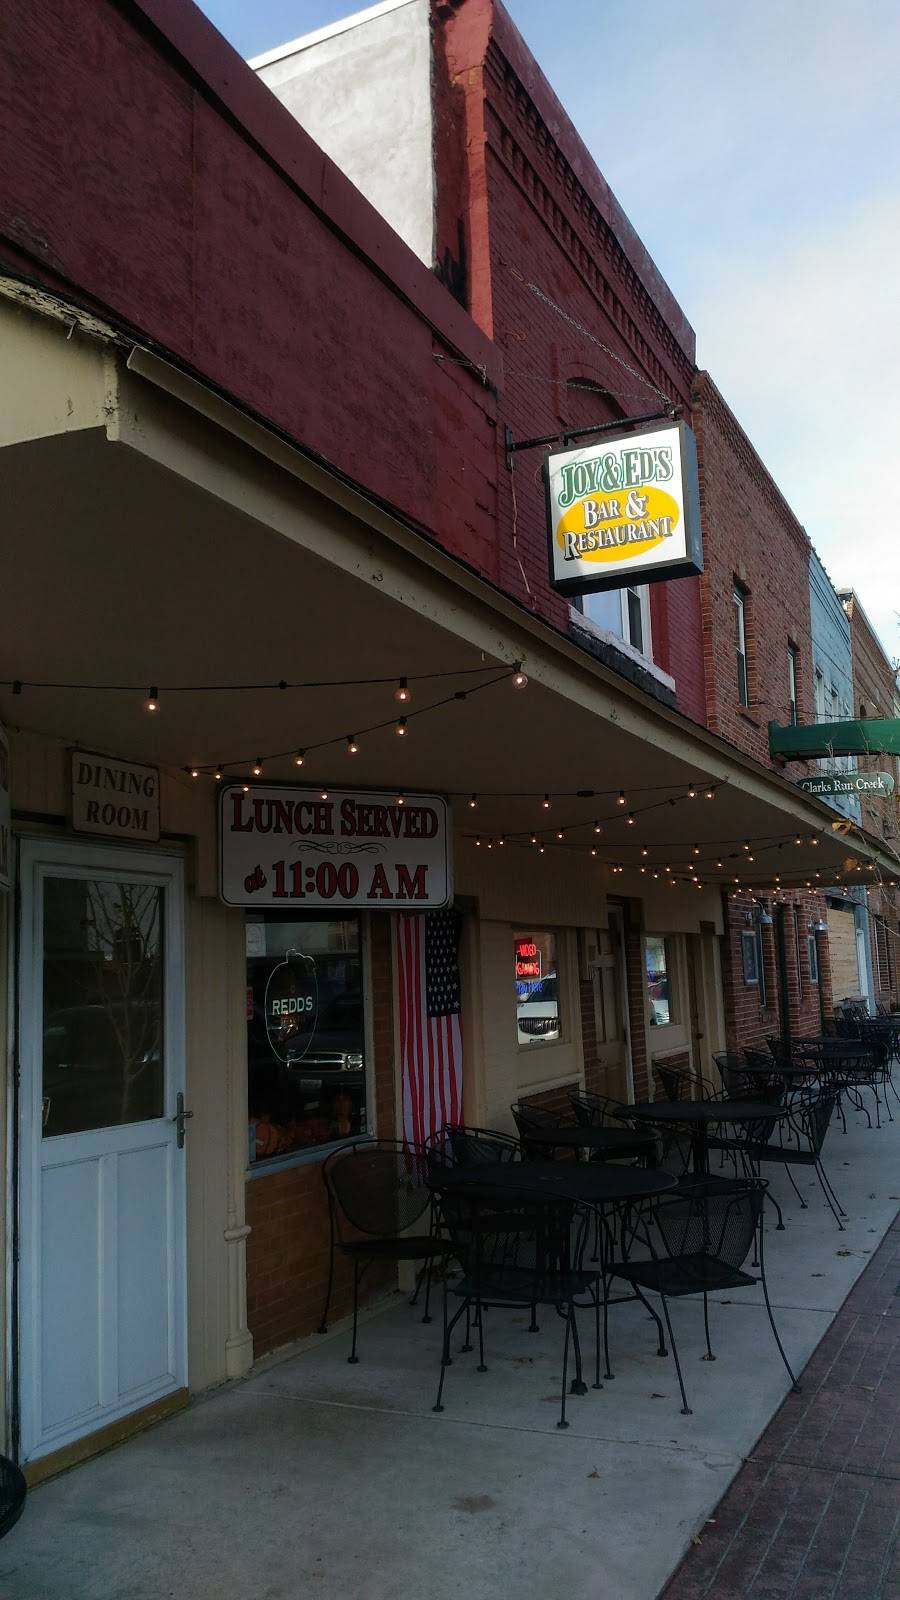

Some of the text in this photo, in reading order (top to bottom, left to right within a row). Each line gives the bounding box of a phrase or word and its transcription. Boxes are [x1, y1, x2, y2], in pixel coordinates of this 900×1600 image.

[583, 490, 648, 529] BAR &
[563, 516, 673, 561] RESTAURANT
[78, 762, 155, 798] DINING
[802, 776, 885, 793] Clarks Run Creek
[86, 800, 149, 831] ROOM
[230, 793, 439, 839] LUNCH SERVED
[244, 860, 429, 900] at 11:00 AM
